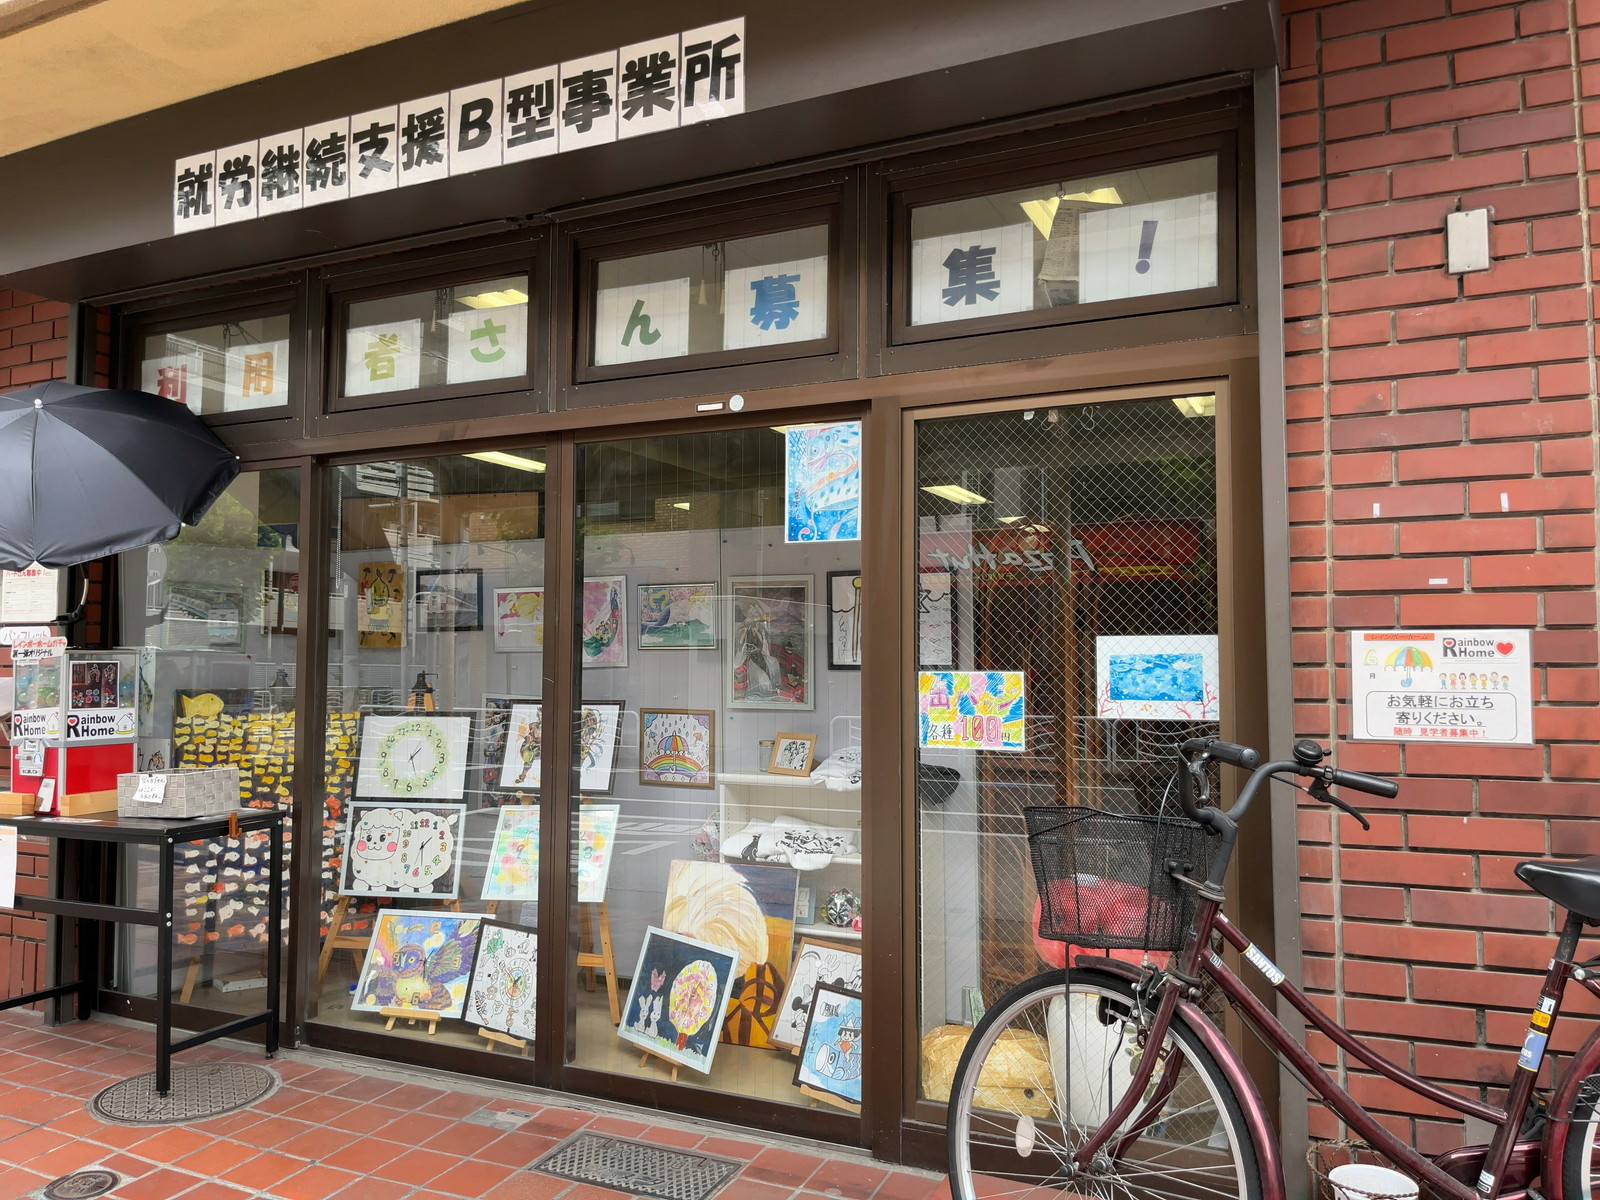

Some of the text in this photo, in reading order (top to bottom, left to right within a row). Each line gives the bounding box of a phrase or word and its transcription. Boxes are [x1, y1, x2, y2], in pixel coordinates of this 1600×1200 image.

[176, 34, 741, 219] 就労継続支援B型事業所
[1443, 637, 1495, 657] Rainbow
[1459, 647, 1495, 657] Home
[1387, 694, 1494, 709] お気軽にお立ち
[14, 713, 47, 737] Rainbow
[66, 713, 116, 738] Rainbow
[1395, 711, 1483, 727] 寄りください。
[23, 725, 46, 736] Home
[81, 727, 116, 737] Home
[1245, 947, 1282, 984] SANTOS
